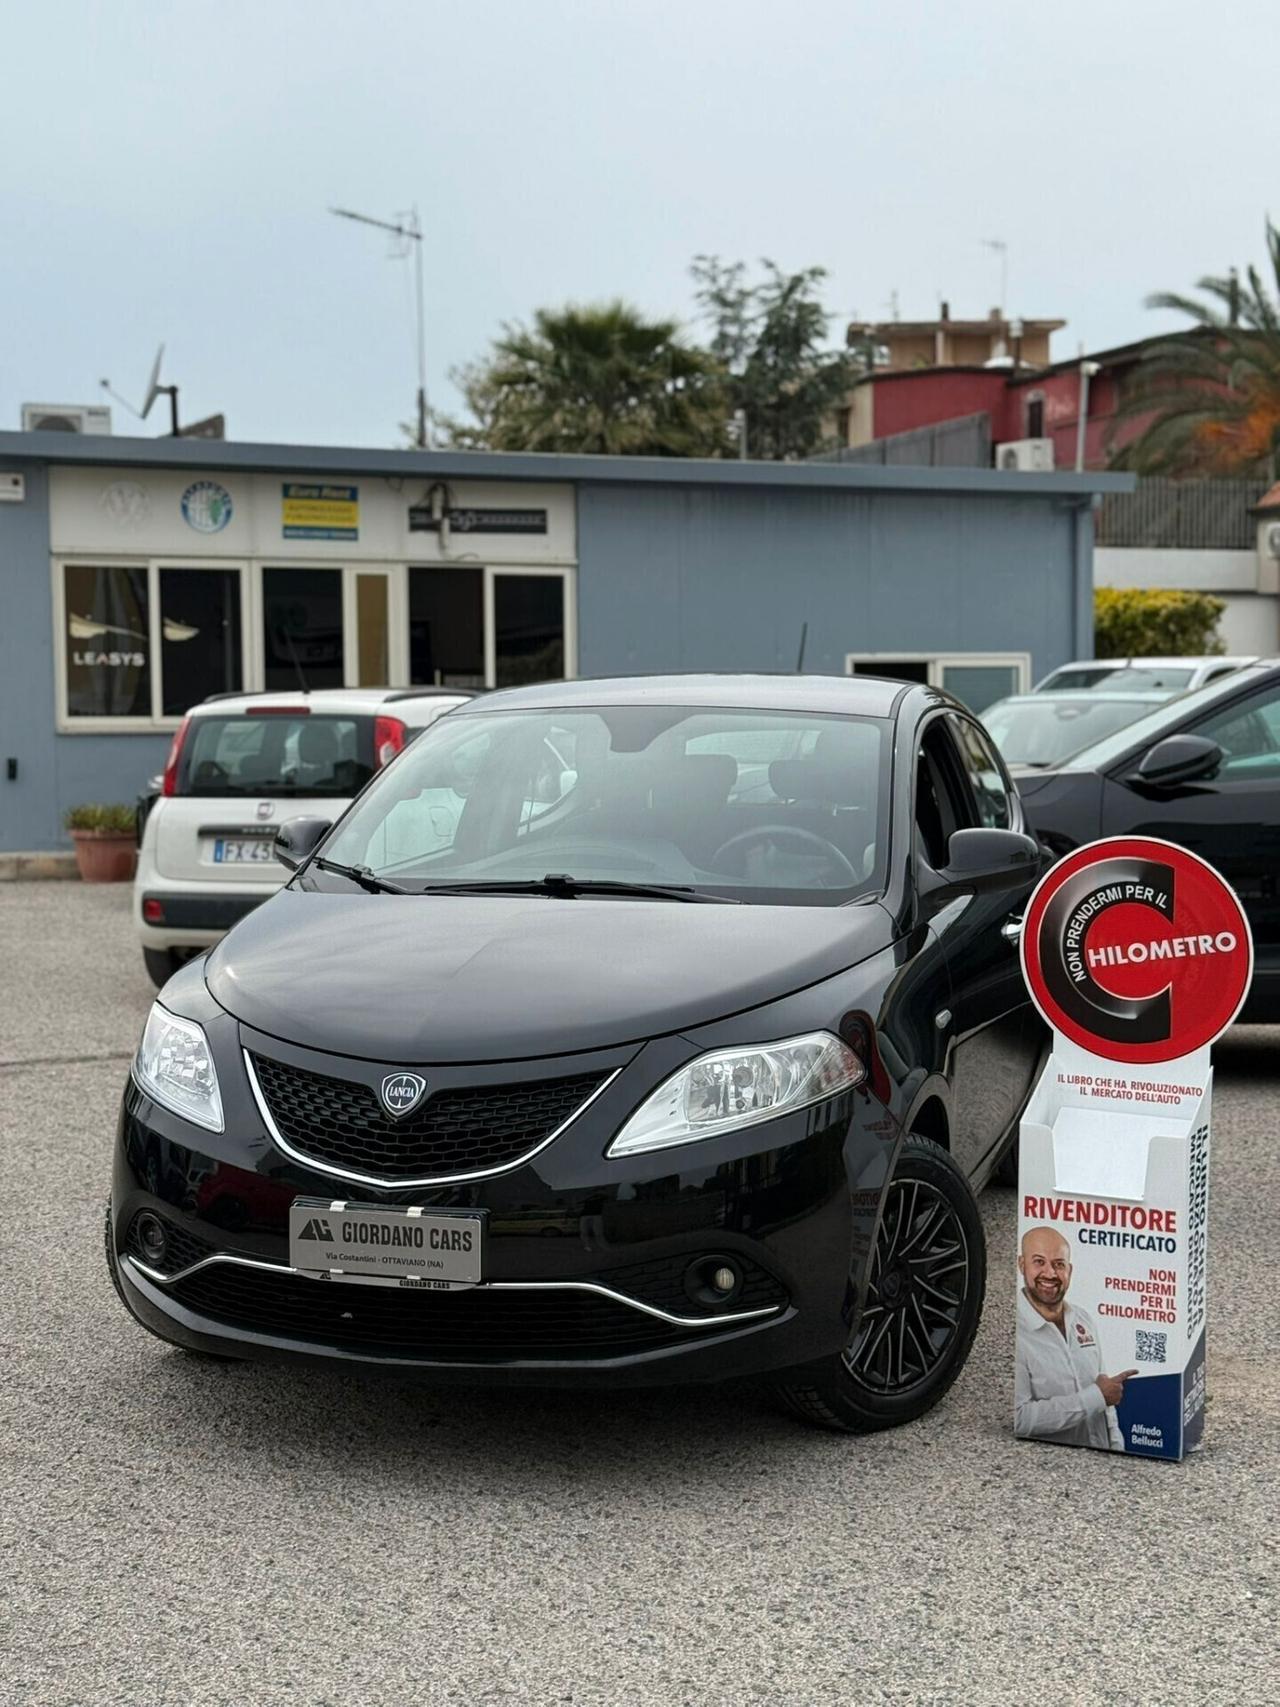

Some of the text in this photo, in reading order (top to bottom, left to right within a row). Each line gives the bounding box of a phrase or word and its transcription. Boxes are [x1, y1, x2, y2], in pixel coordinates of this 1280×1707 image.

[73, 651, 145, 667] LEASYS
[1066, 885, 1167, 982] NON PRENDERMI PER IL
[390, 1086, 414, 1098] LANCIA
[1057, 1074, 1203, 1097] IL LIBRO CHE HA RIVOLUZIONATO
[1080, 1086, 1181, 1105] IL MERCATO DELL'AUTO
[1024, 1195, 1177, 1233] RIVENDITORE
[342, 1221, 424, 1249] GIORDANO
[429, 1228, 473, 1252] CARS
[1078, 1228, 1177, 1254] CERTIFICATO
[326, 1252, 338, 1260] Via
[339, 1253, 377, 1263] Costantini
[382, 1256, 426, 1267] OTTAVIANO
[427, 1259, 444, 1270] (NA)
[1149, 1268, 1176, 1283] NON
[399, 1280, 431, 1289] GIORDANO
[432, 1281, 450, 1290] CARS
[1104, 1276, 1176, 1297] PRENDERMI
[1140, 1295, 1177, 1310] PER IL
[1097, 1303, 1176, 1324] CHILOMETRO
[1131, 1423, 1162, 1437] Alfredo
[1131, 1434, 1164, 1448] Bellucci
